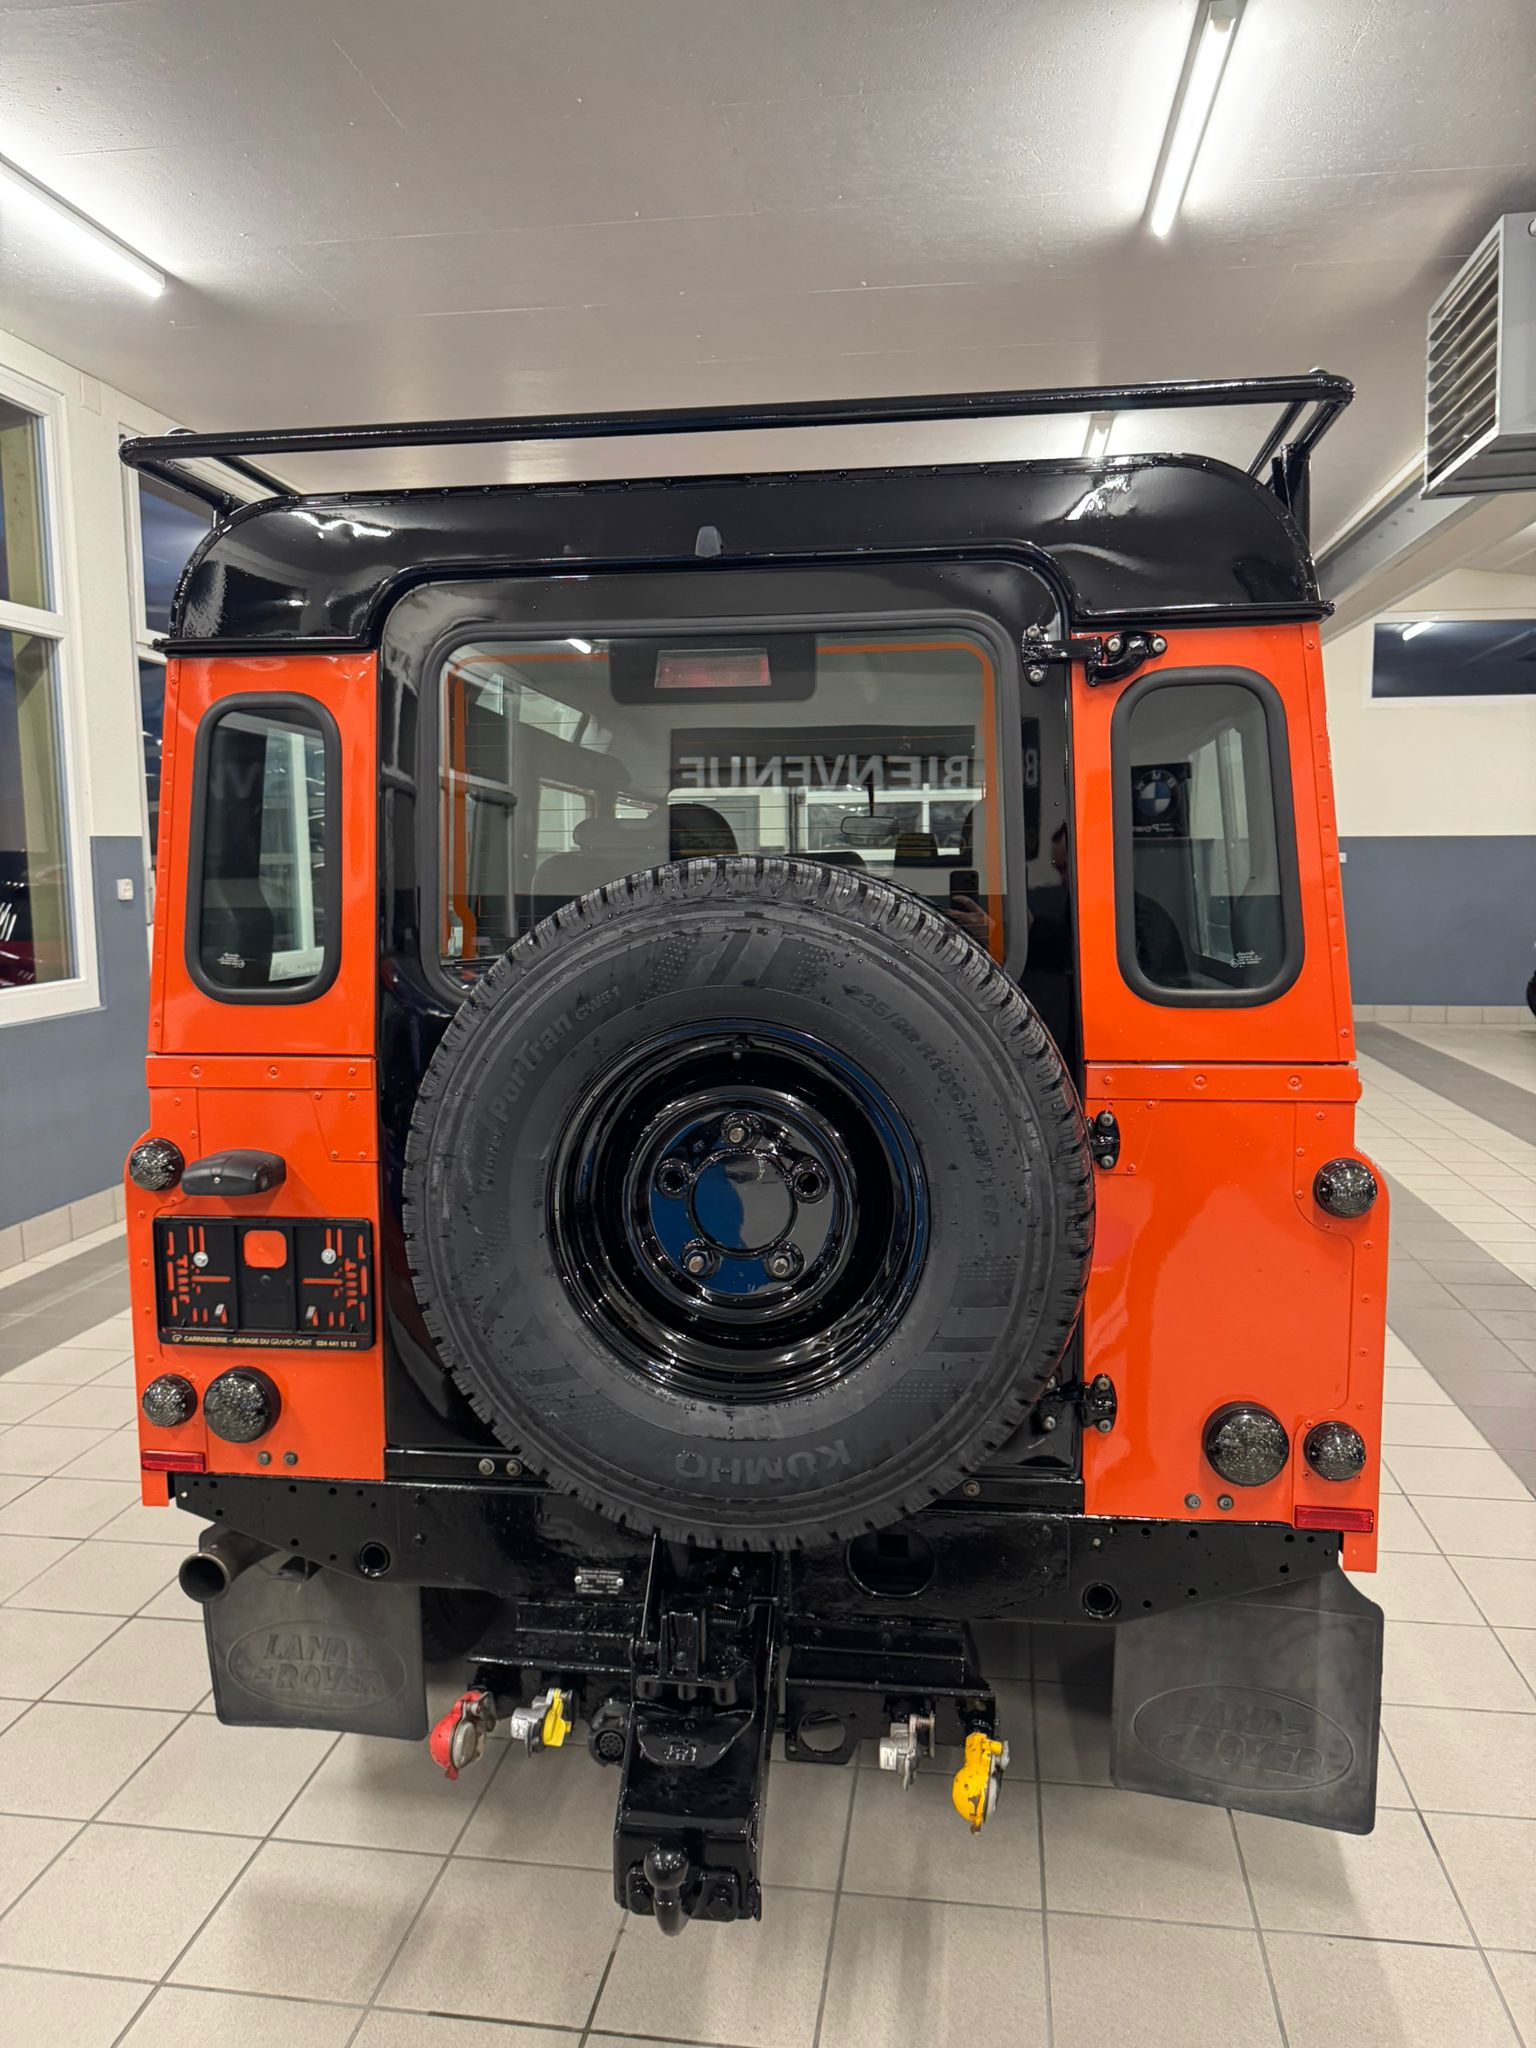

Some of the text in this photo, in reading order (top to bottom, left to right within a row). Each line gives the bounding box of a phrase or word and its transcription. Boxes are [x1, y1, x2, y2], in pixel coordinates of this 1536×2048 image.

[488, 1013, 574, 1124] PorTran
[183, 1336, 228, 1344] CARROSSERIE
[233, 1337, 259, 1345] GARAGE
[271, 1338, 313, 1346] GRAND-PONT
[675, 1439, 851, 1485] KUMHO
[262, 1633, 351, 1664] LAND
[275, 1663, 385, 1696] ROVER
